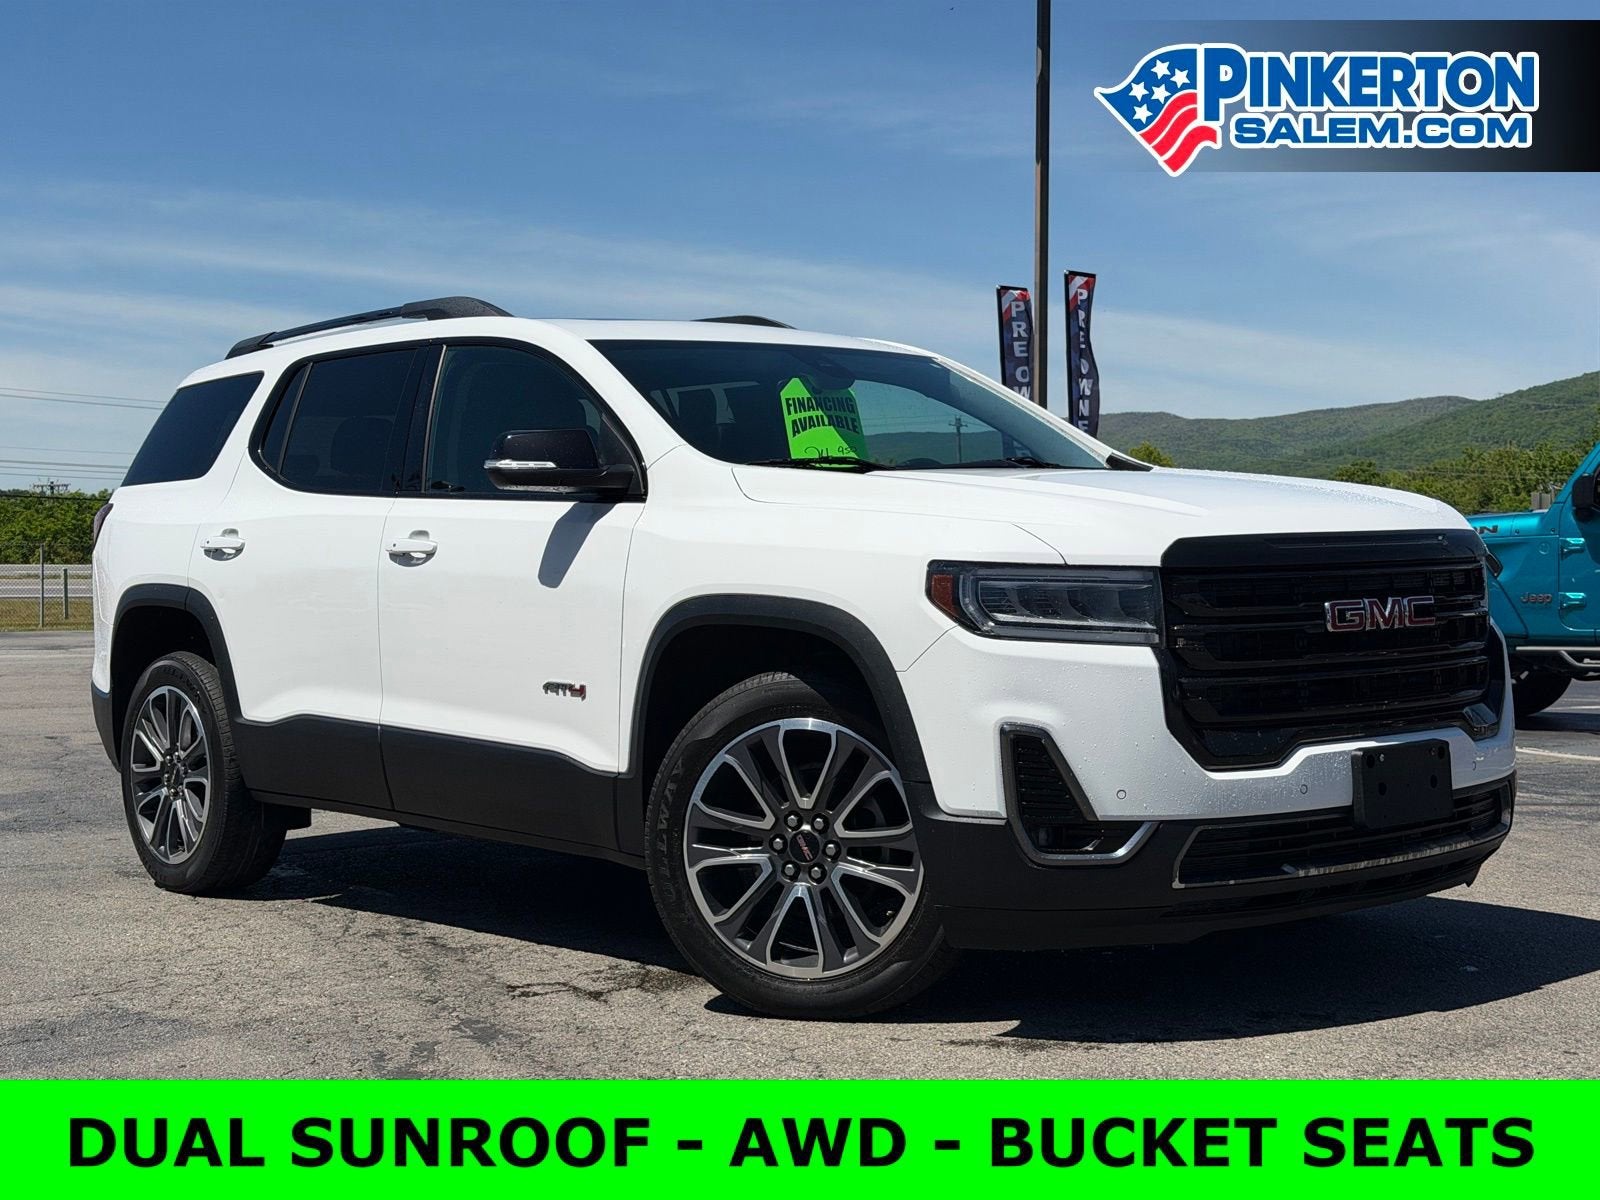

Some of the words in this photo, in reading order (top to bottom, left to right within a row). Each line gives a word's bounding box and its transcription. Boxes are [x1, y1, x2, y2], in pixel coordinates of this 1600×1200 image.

[1011, 301, 1028, 358] PRE
[1077, 288, 1089, 349] PRE
[785, 396, 856, 416] FINANCING
[791, 414, 860, 438] AVAILABLE
[1519, 592, 1553, 604] Jeep
[1324, 595, 1436, 632] GMC
[542, 681, 587, 702] AT4
